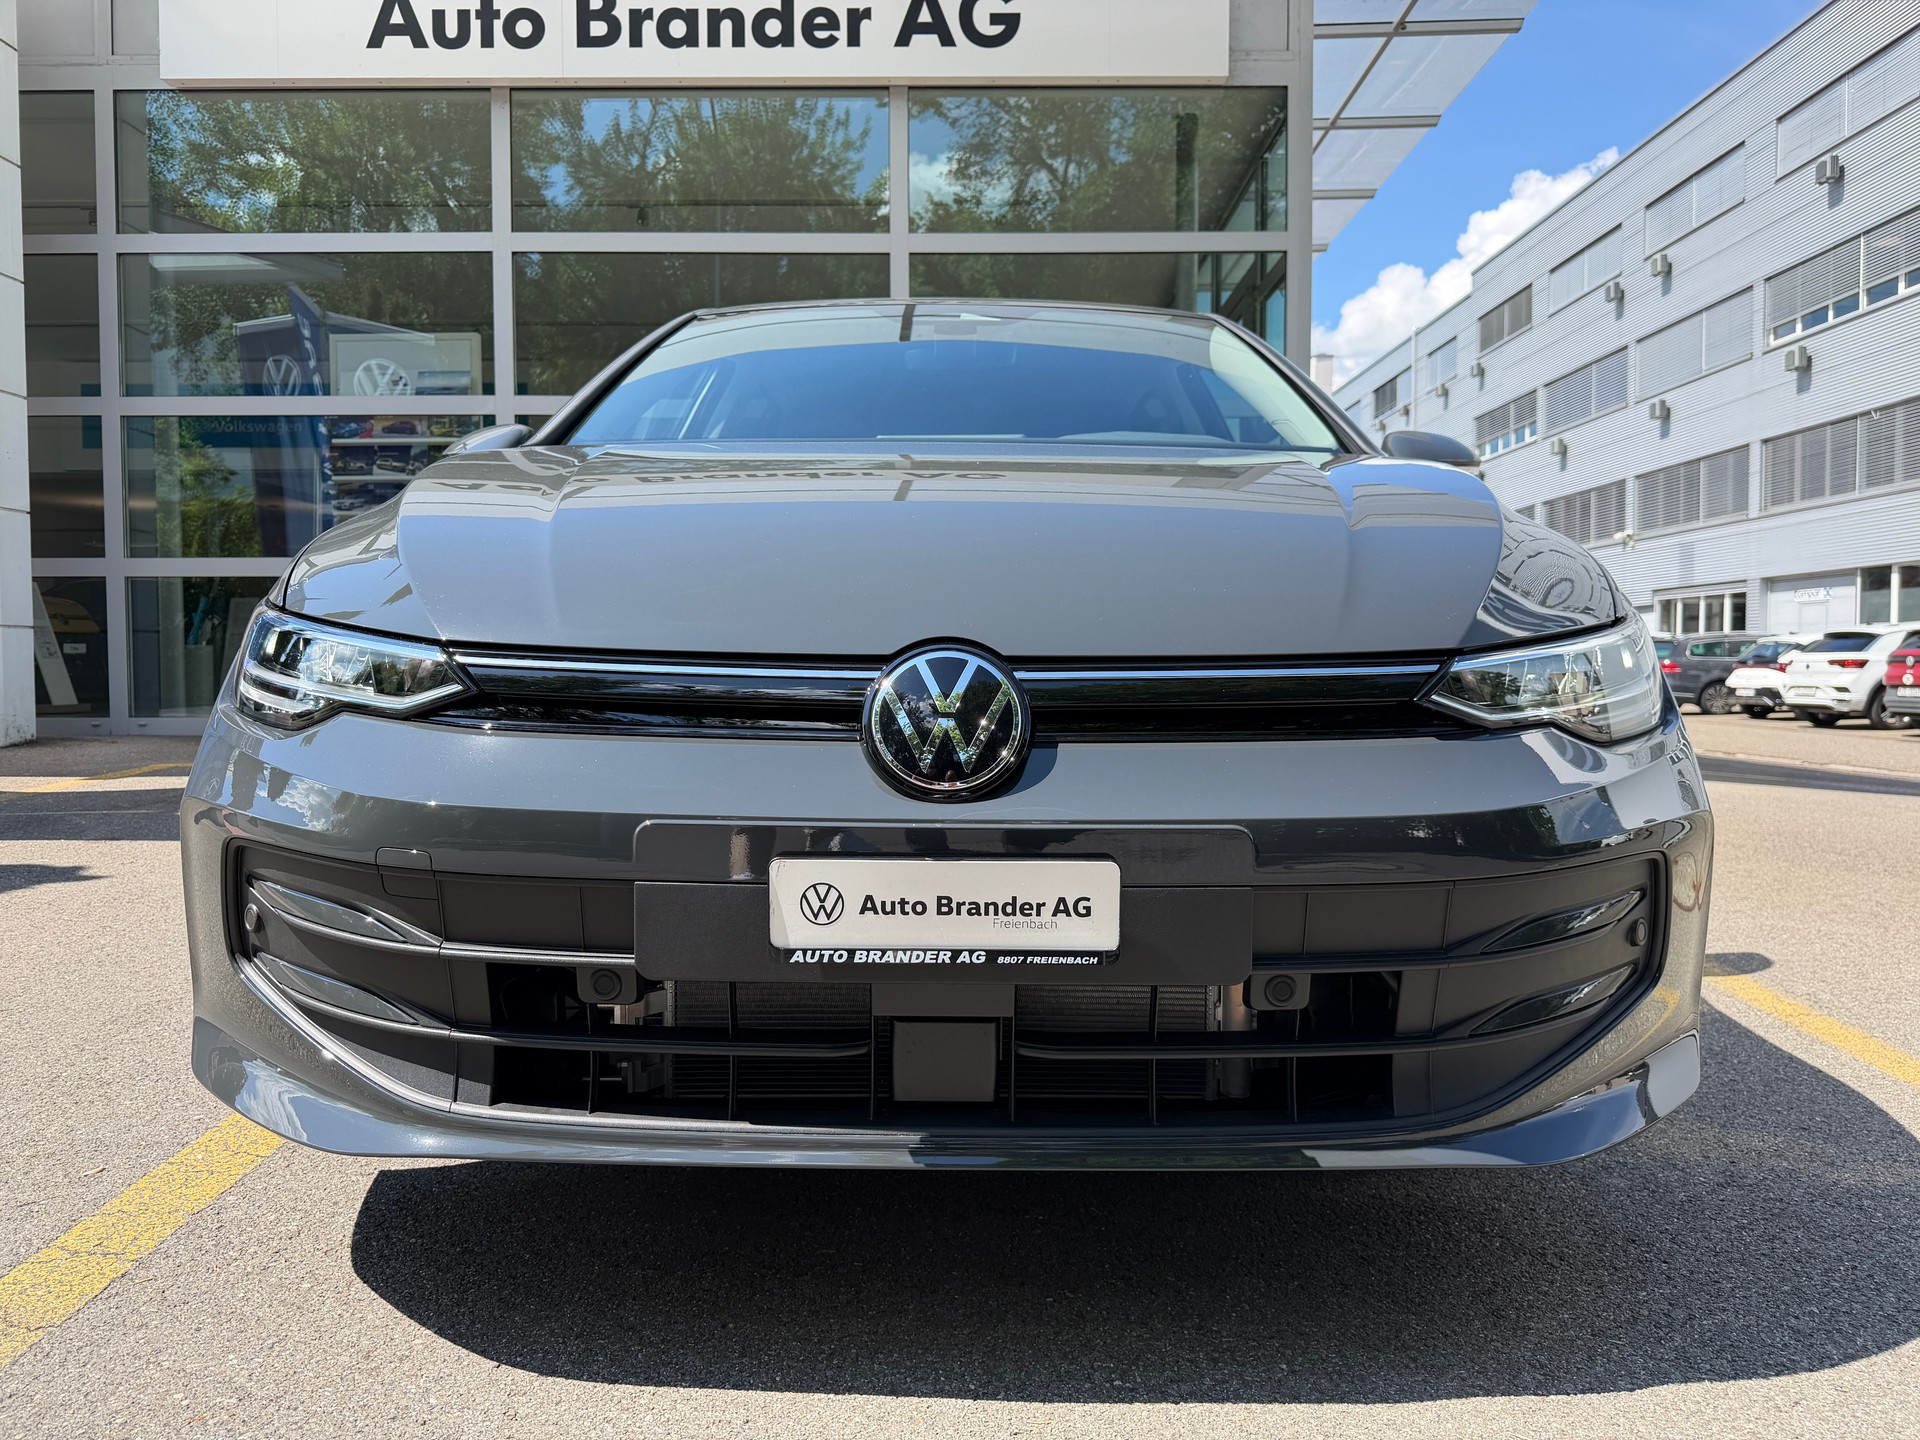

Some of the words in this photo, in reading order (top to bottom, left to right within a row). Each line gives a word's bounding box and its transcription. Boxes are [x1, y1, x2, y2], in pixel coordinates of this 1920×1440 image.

[366, 0, 546, 50] Auto
[576, 0, 872, 49] Brander
[894, 0, 1021, 49] AG
[859, 894, 928, 916] Auto
[936, 895, 1046, 917] Brander
[1051, 897, 1092, 917] AG
[993, 917, 1058, 929] Freienbach
[789, 950, 848, 963] AUTO
[853, 950, 951, 963] BRANDER
[956, 951, 986, 964] AG
[997, 956, 1024, 964] 8807
[1026, 956, 1098, 965] FREIENBACH
